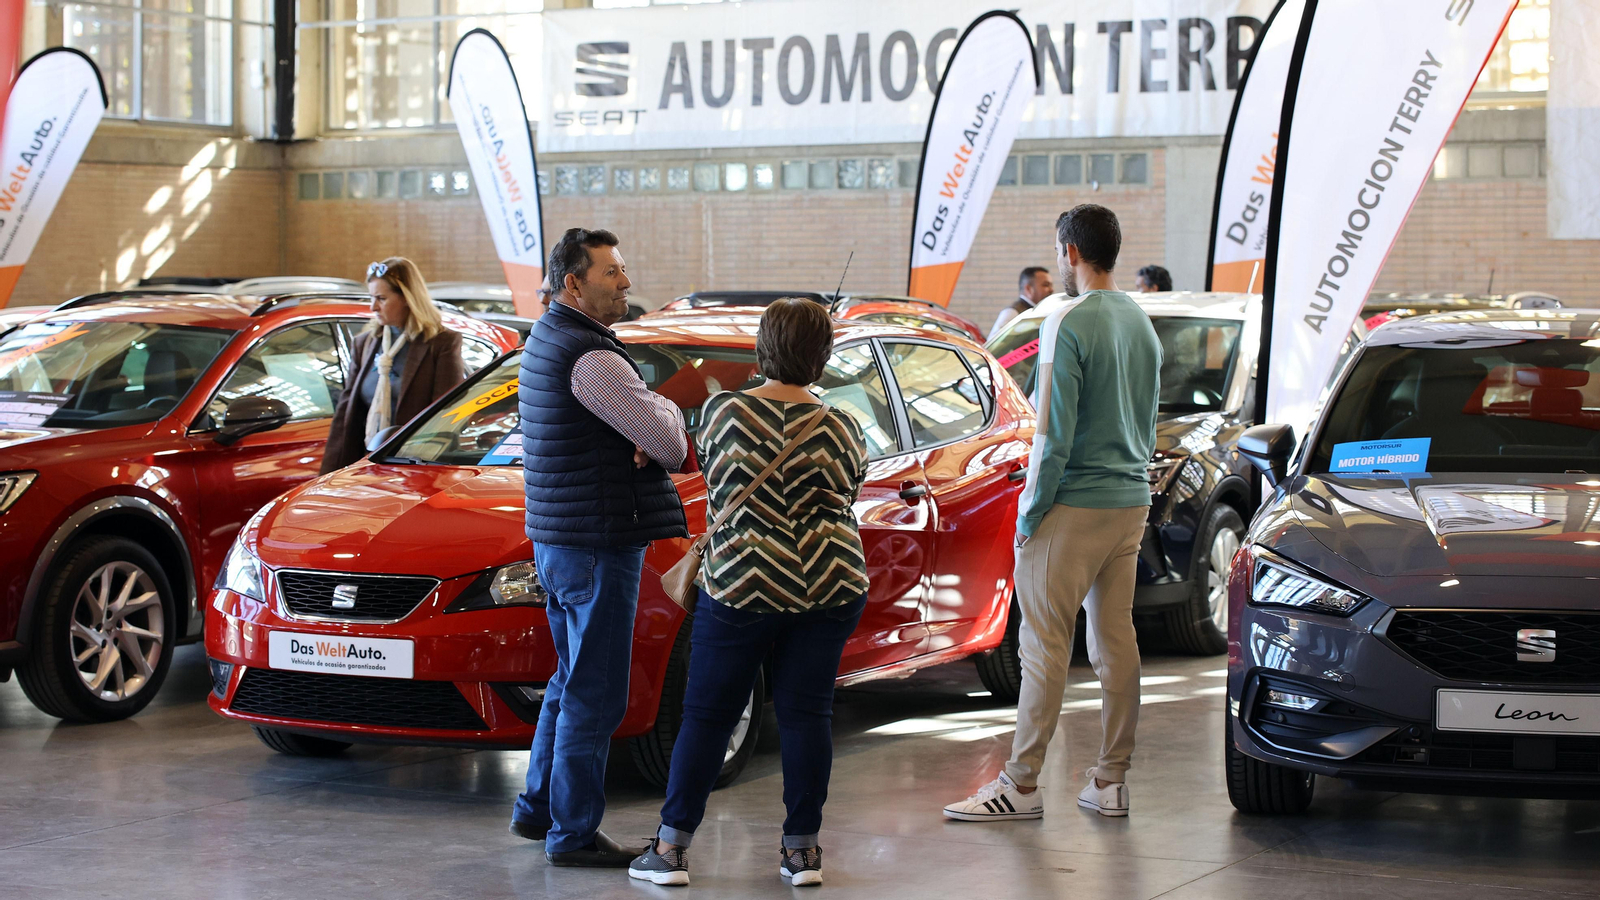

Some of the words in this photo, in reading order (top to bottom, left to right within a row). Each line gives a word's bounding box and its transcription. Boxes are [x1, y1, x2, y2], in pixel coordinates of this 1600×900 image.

[658, 10, 1074, 110] AUTOMOCN
[1097, 16, 1265, 94] TERR
[554, 109, 647, 127] SEAT
[921, 203, 949, 251] Das
[939, 90, 997, 199] WeltAuto.
[1303, 137, 1404, 335] AUTOMOCION
[1389, 49, 1443, 135] TERRY
[1225, 191, 1265, 246] Das
[475, 381, 520, 405] OCA
[1338, 456, 1375, 468] MOTOR
[1377, 453, 1420, 464] HÍBRIDO
[291, 640, 314, 655] Das
[316, 642, 386, 660] WeltAuto.
[347, 663, 386, 671] garantizados
[1495, 703, 1579, 721] Leon
